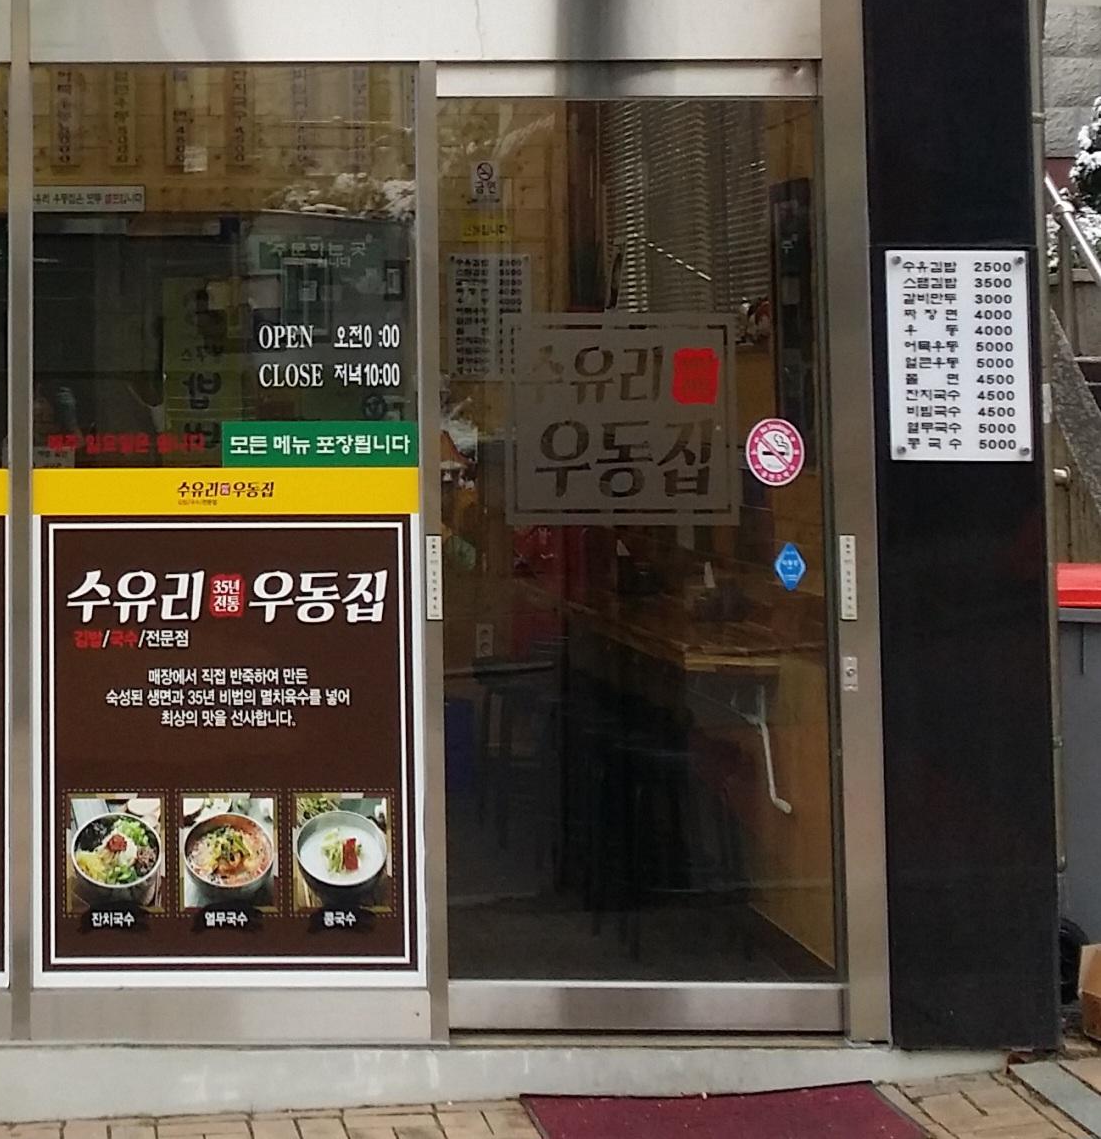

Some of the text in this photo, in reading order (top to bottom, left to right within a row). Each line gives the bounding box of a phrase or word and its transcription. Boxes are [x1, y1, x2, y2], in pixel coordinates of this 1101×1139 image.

[902, 261, 1012, 273] 수유김밥 2500
[903, 277, 1013, 289] 스팸김밥 3500
[974, 294, 1013, 304] 3000
[974, 310, 1013, 320] 4000
[259, 325, 314, 349] OPEN
[974, 326, 1013, 336] 4000
[976, 342, 1014, 352] 5000
[976, 358, 1014, 368] 5000
[259, 363, 323, 387] CLOSE
[976, 375, 1015, 385] 4500
[906, 389, 1015, 401] 잔치국수 4500
[907, 405, 1016, 417] 비빔국수 4500
[978, 424, 1017, 434] 5000
[230, 434, 410, 455] 모든 메뉴 포장됩니다
[979, 439, 1017, 449] 5000
[535, 419, 714, 498] 우동집
[177, 481, 219, 498] 수유리
[232, 481, 275, 498] 우동집
[212, 579, 241, 595] 35년
[66, 569, 206, 623] 수유리
[212, 595, 241, 612] 전통
[248, 569, 388, 623] 우동집
[148, 668, 308, 685] 매장에서 직접 반죽하여 만든
[105, 689, 351, 706] 숙성된 생면과 35년 비법의 멸치육수를 넣어
[161, 710, 297, 727] 최상의 맛을 선사합니다.
[91, 911, 135, 927] 잔치국수
